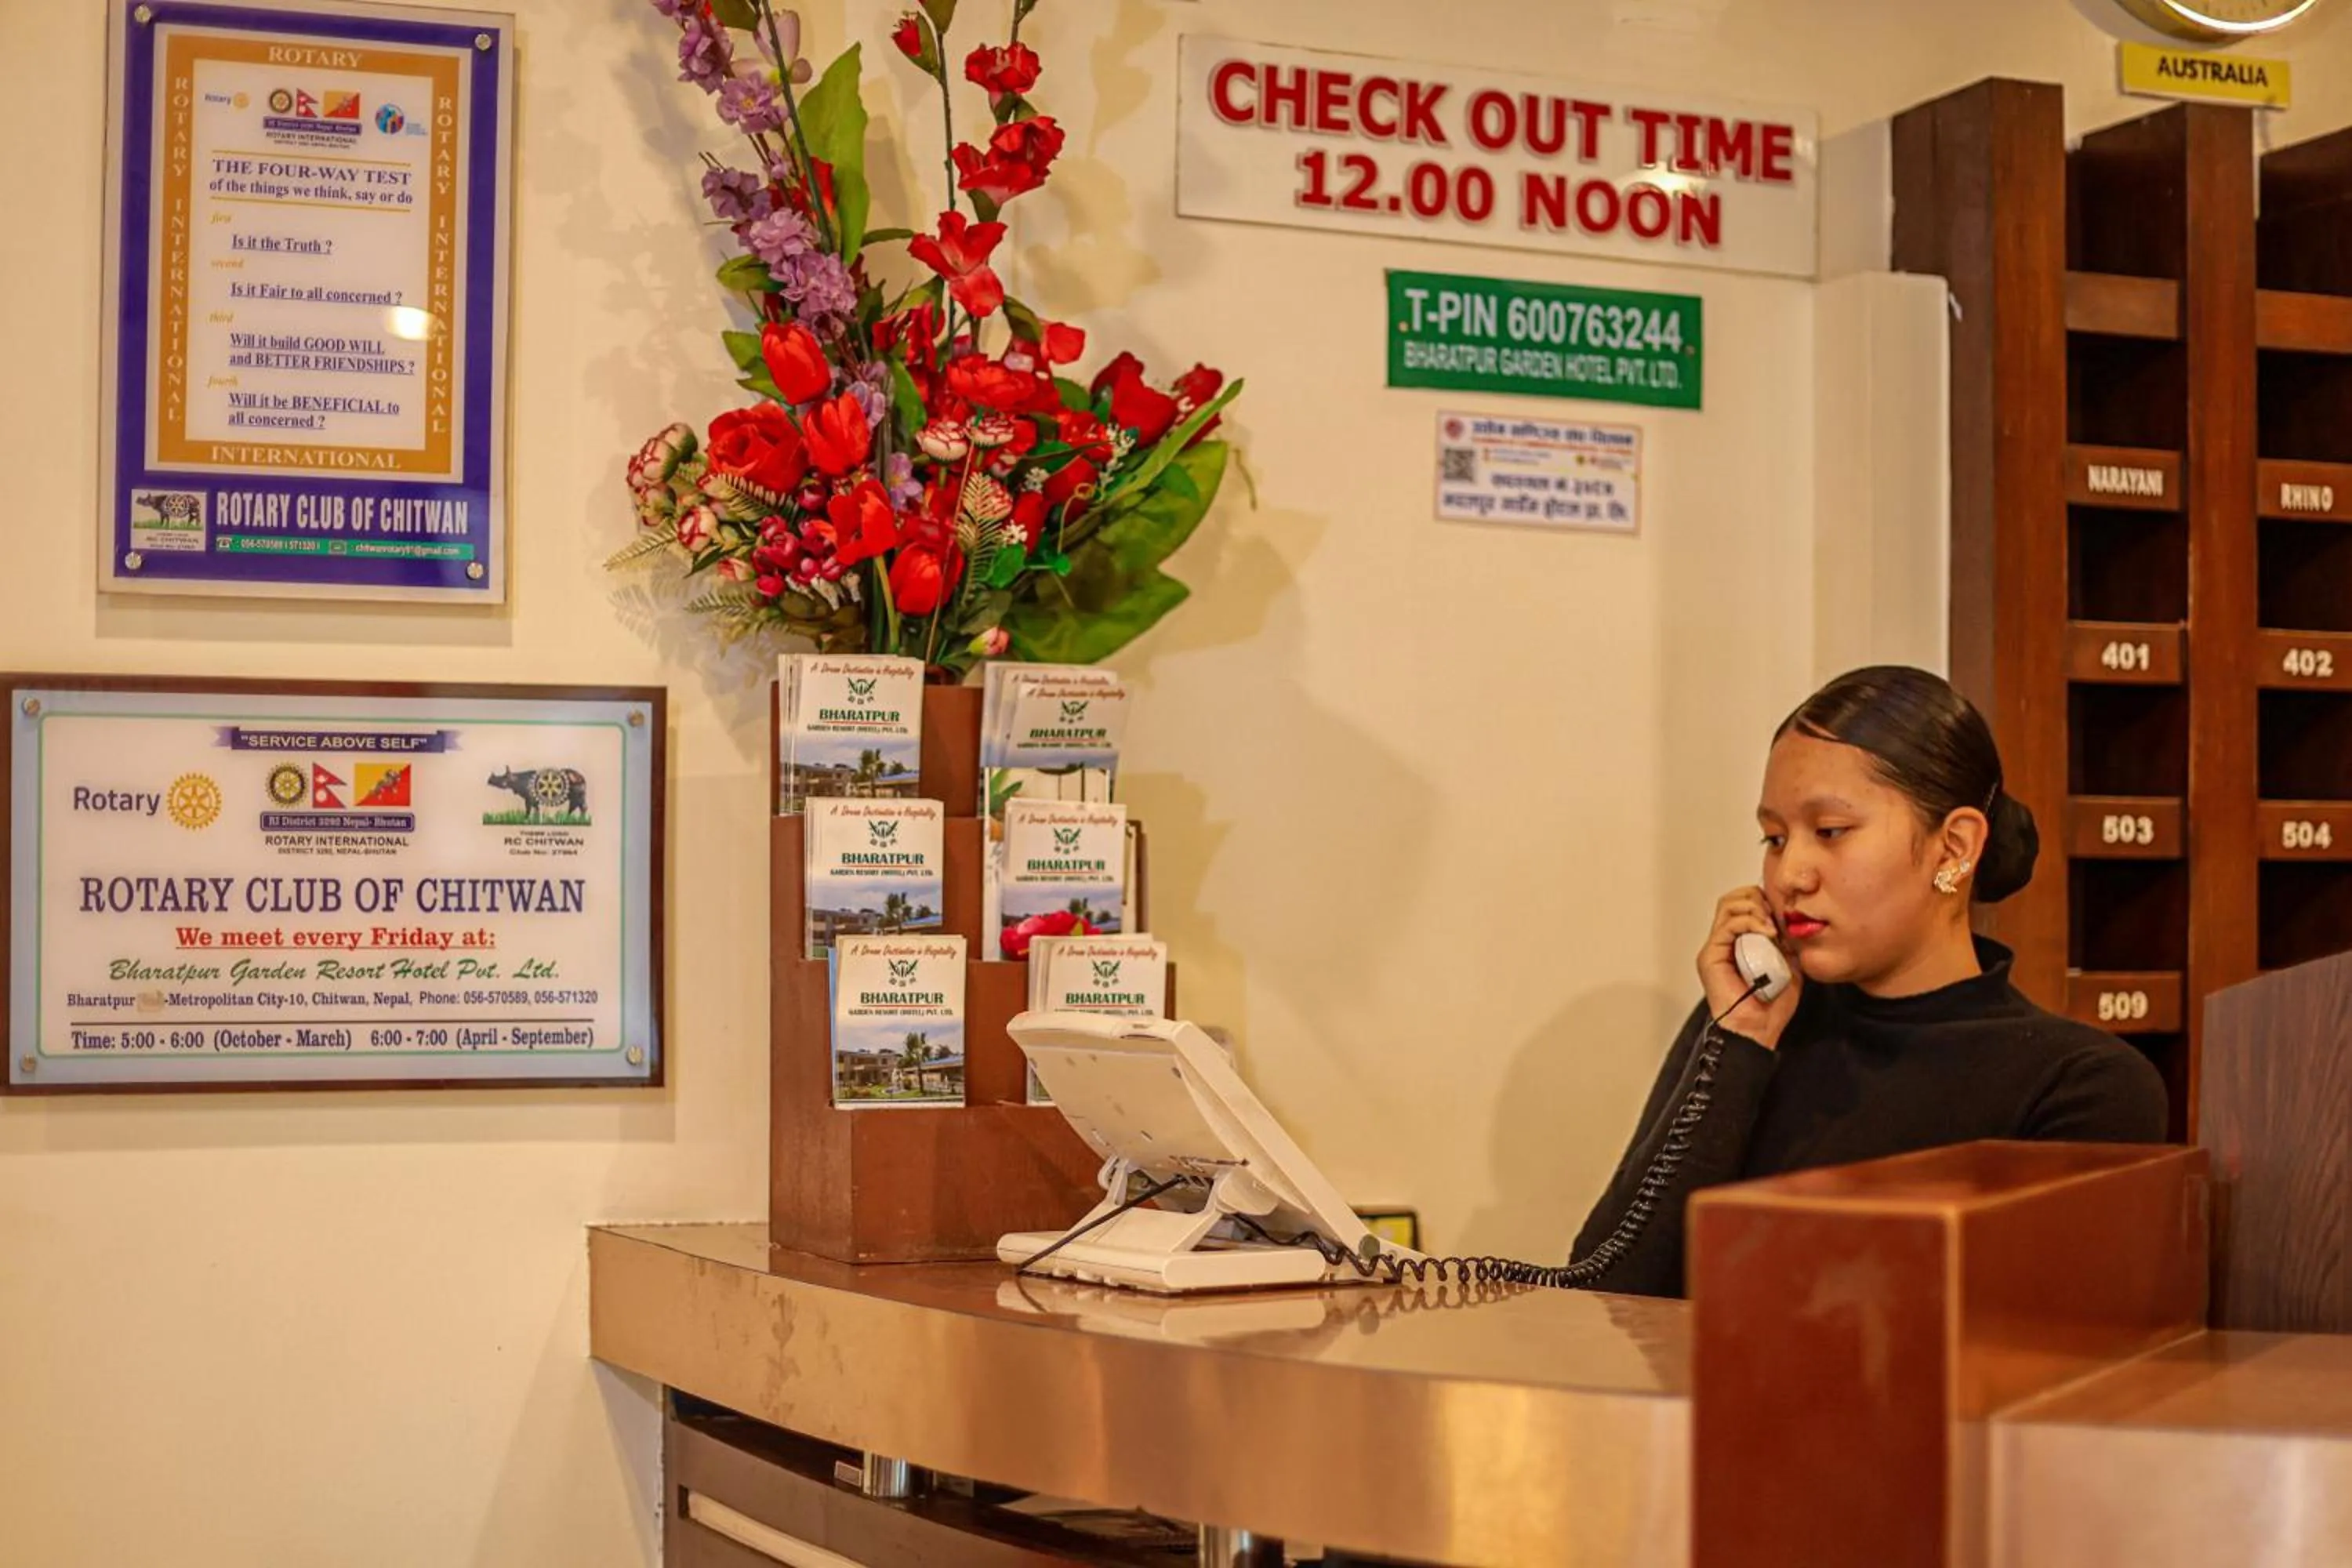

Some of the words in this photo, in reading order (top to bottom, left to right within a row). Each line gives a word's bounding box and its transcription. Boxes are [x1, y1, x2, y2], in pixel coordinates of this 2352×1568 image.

[269, 46, 362, 69] ROTARY
[2158, 56, 2268, 87] AUSTRALIA
[172, 77, 189, 176] ROTARY
[1211, 60, 1449, 144] CHECK
[1468, 89, 1612, 160] OUT
[1629, 108, 1794, 181] TIME
[437, 96, 452, 194] ROTARY
[212, 158, 252, 175] THE
[258, 163, 359, 182] FOUR-WAY
[364, 169, 412, 186] TEST
[209, 179, 224, 192] of
[226, 180, 246, 193] the
[250, 182, 289, 199] things
[294, 187, 311, 197] we
[314, 185, 352, 201] think,
[355, 190, 375, 205] say
[379, 192, 394, 202] or
[397, 190, 413, 204] do
[1295, 150, 1495, 223] 12.00
[1523, 173, 1722, 245] NOON
[232, 234, 244, 249] Is
[247, 235, 257, 249] it
[261, 237, 281, 251] the
[284, 238, 321, 253] Truth
[230, 282, 242, 296] Is
[247, 283, 256, 296] it
[260, 284, 287, 298] Fair
[291, 286, 303, 299] to
[307, 287, 322, 300] all
[327, 289, 391, 304] concerned
[167, 198, 185, 422] INTERNATIONAL
[1405, 289, 1497, 337] T-PIN
[1507, 296, 1683, 354] 600763244
[431, 215, 449, 433] INTERNATIONAL
[230, 332, 255, 348] Will
[258, 335, 268, 348] it
[270, 335, 300, 350] build
[304, 337, 345, 351] GOOD
[349, 340, 384, 354] WILL
[230, 353, 252, 365] and
[256, 354, 310, 368] BETTER
[314, 357, 405, 372] FRIENDSHIPS
[1404, 340, 1497, 374] BHARATPUR
[1501, 348, 1563, 380] GARDEN
[1565, 354, 1613, 384] HOTEL
[1650, 360, 1683, 389] LTD.
[229, 392, 256, 407] Will
[260, 394, 270, 407] it
[274, 395, 289, 408] be
[292, 396, 384, 412] BENEFICIAL
[387, 401, 400, 414] to
[228, 413, 244, 425] all
[248, 414, 313, 427] concerned
[212, 445, 400, 469] INTERNATIONAL
[2281, 483, 2333, 511] RHINO
[216, 492, 290, 528] ROTARY
[297, 495, 345, 530] CLUB
[352, 497, 374, 532] OF
[380, 498, 468, 535] CHITWAN
[2101, 641, 2150, 670] 401
[2283, 648, 2333, 677] 402
[819, 709, 900, 722] BHARATPUR
[321, 736, 376, 749] ABOVE
[1029, 728, 1106, 739] BHARATPUR
[74, 786, 161, 816] Rotary
[282, 816, 316, 826] District
[375, 817, 407, 827] Bhutan
[2103, 815, 2154, 844] 503
[265, 835, 312, 846] ROTARY
[315, 836, 409, 847] INTERNATIONAL
[526, 837, 584, 846] CHITWAN
[2282, 822, 2332, 849] 504
[841, 853, 924, 864] BHARATPUR
[1028, 859, 1105, 870] BHARATPUR
[79, 877, 234, 912] ROTARY
[245, 877, 341, 913] CLUB
[355, 877, 404, 913] OF
[416, 878, 586, 913] CHITWAN
[176, 927, 212, 946] We
[220, 927, 284, 946] meet
[292, 931, 362, 950] every
[370, 927, 453, 950] Friday
[462, 927, 495, 946] at:
[108, 958, 222, 983] Bharatpur
[230, 958, 307, 985] Garden
[316, 959, 385, 980] Resort
[390, 957, 450, 980] Hotel
[456, 958, 501, 980] Pvt.
[511, 957, 560, 979] Ltd.
[67, 993, 136, 1010] Bharatpur
[257, 992, 308, 1009] City-10,
[312, 991, 369, 1007] Chitwan,
[373, 991, 413, 1008] Nepal,
[419, 991, 460, 1005] Phone:
[463, 991, 532, 1006] 056-570589,
[534, 990, 597, 1004] 056-571320
[860, 992, 943, 1004] BHARATPUR
[1065, 993, 1145, 1004] BHARATPUR
[2098, 991, 2148, 1020] 509
[71, 1031, 115, 1050] Time:
[121, 1031, 154, 1048] 5:00
[170, 1030, 204, 1048] 6:00
[213, 1029, 280, 1051] (October
[296, 1029, 352, 1051] March)
[371, 1029, 402, 1047] 6:00
[416, 1029, 448, 1046] 7:00
[456, 1028, 498, 1049] (April
[511, 1028, 594, 1049] September)
